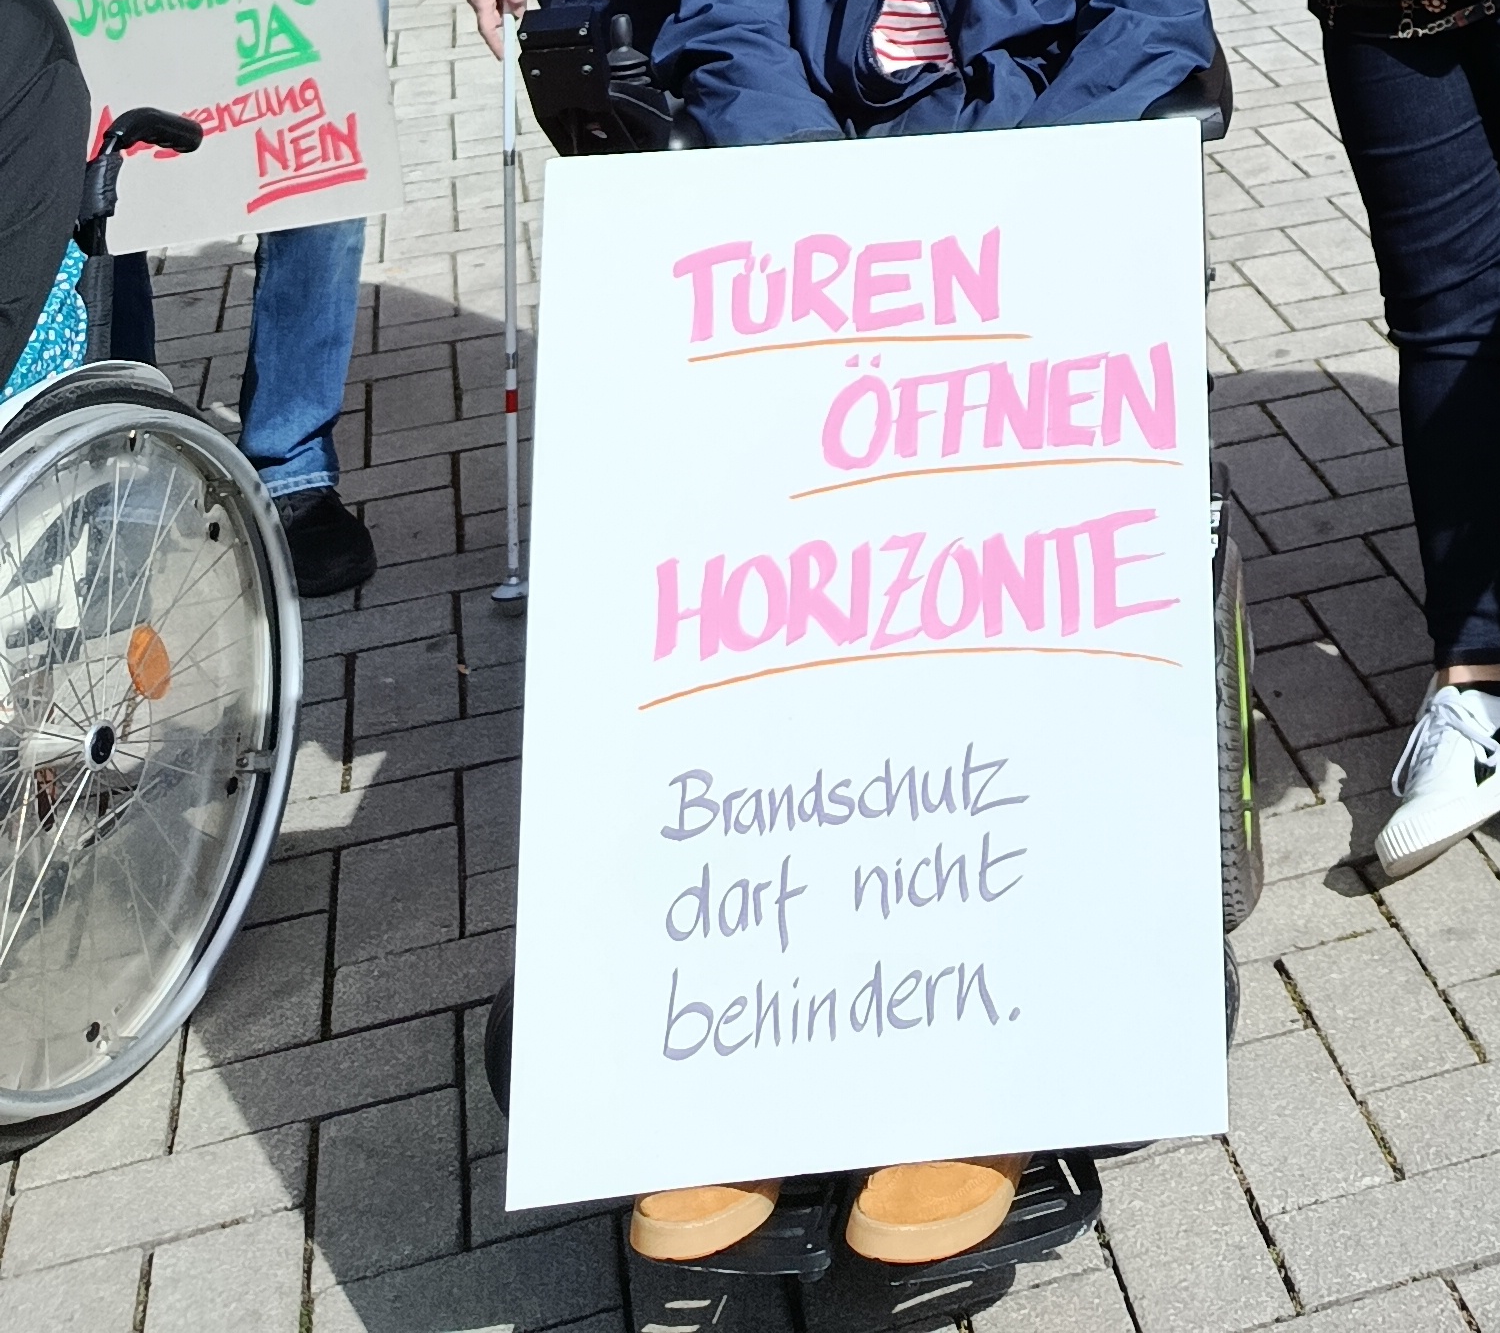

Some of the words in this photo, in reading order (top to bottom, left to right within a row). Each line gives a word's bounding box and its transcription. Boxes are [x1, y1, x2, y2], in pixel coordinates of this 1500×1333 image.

[235, 2, 317, 61] JA
[254, 111, 363, 179] NEIN
[673, 225, 1000, 344] TÜREN
[821, 342, 1177, 471] ÖFFNEN
[653, 507, 1182, 662] HORIZONTE
[660, 741, 1030, 841] Brandschutz
[665, 854, 808, 953] darf
[854, 831, 1028, 920] nicht
[663, 959, 1021, 1061] behindern.
